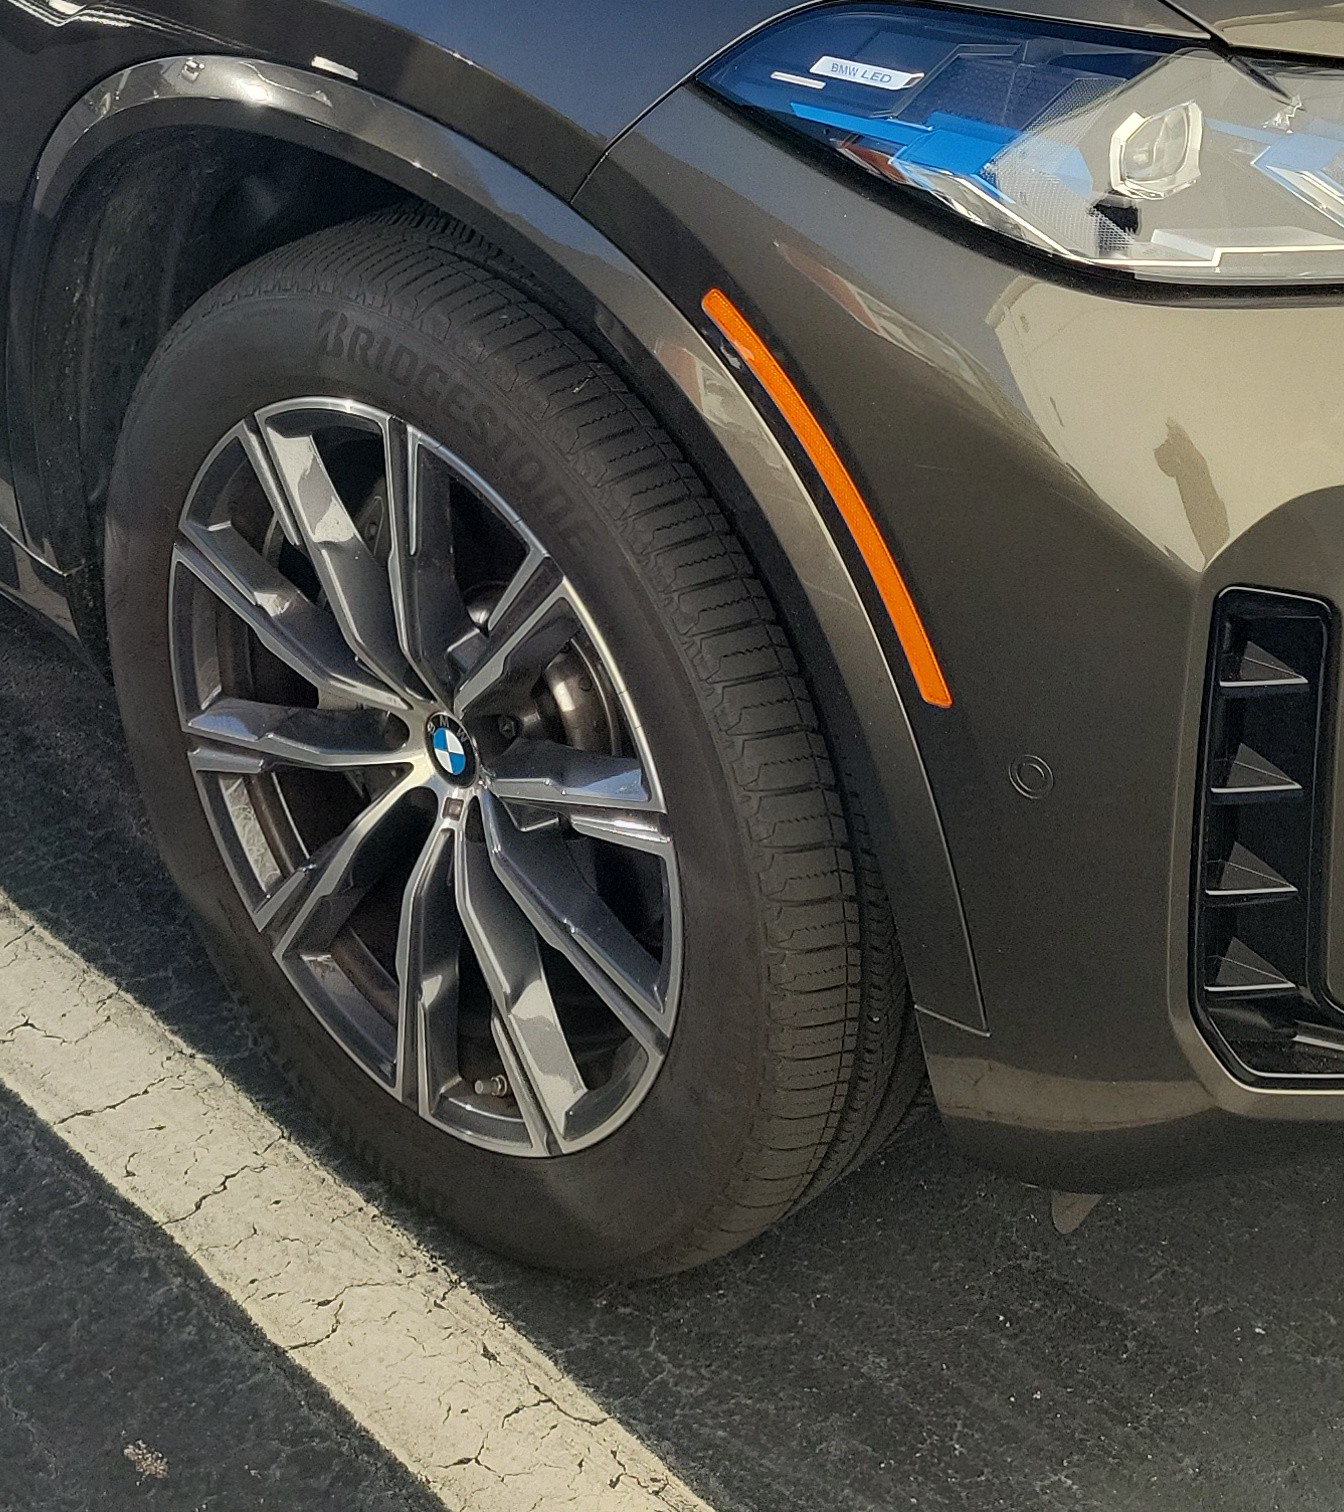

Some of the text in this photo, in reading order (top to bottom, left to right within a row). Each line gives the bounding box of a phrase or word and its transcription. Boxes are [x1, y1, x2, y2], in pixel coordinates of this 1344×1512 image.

[831, 62, 892, 84] BMW LED
[317, 308, 598, 557] BRIDGESTONE
[427, 715, 469, 743] BMW
